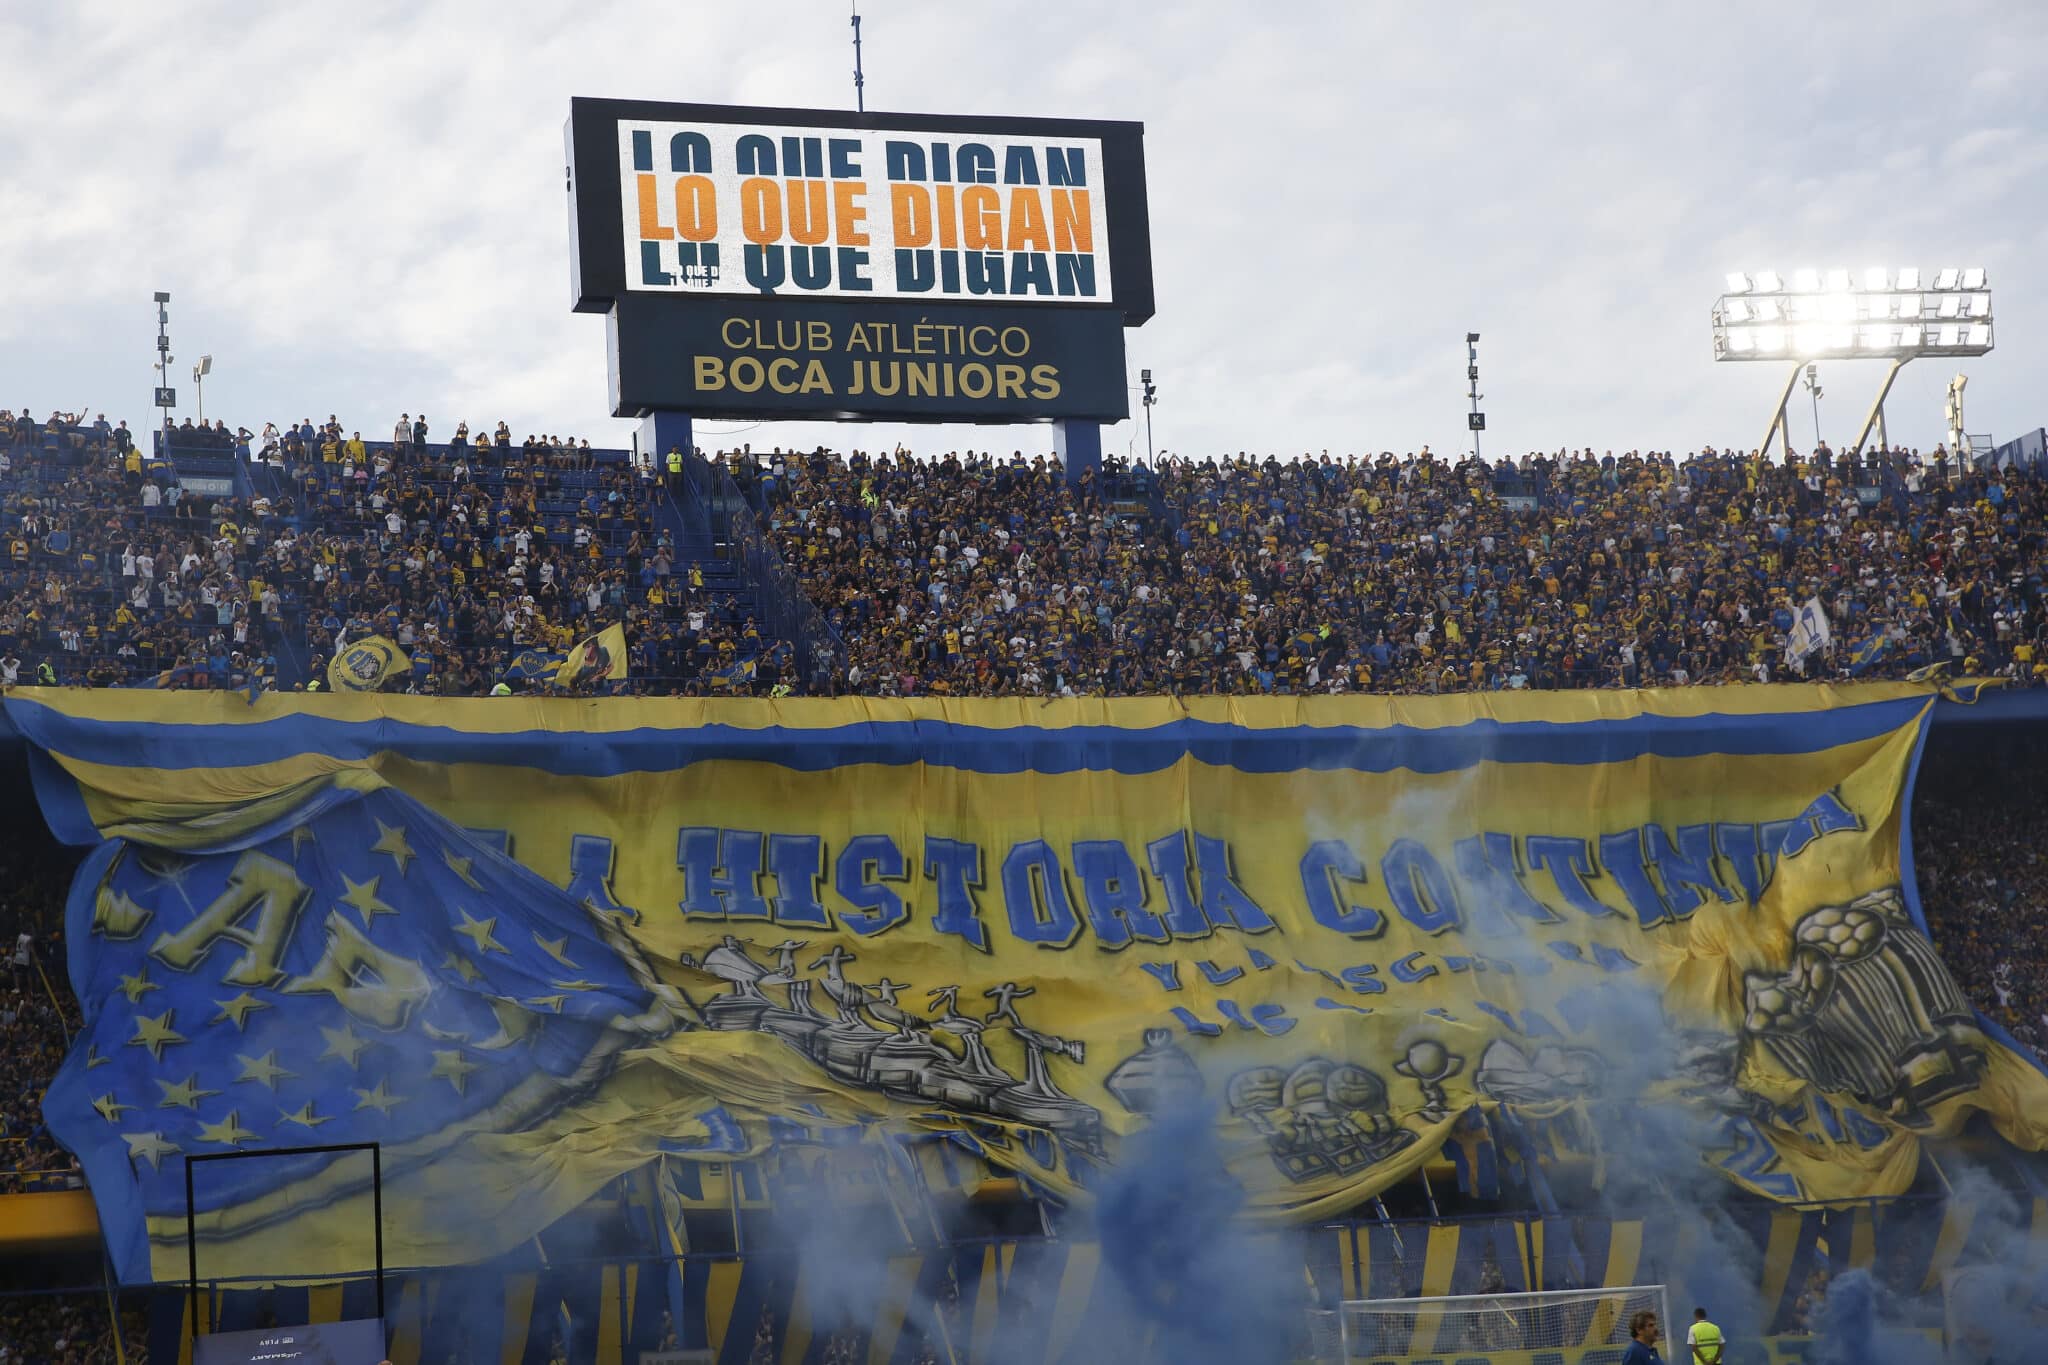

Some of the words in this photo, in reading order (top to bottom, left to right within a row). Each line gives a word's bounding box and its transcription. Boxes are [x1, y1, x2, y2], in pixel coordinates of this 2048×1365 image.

[637, 173, 718, 242] LO
[740, 177, 870, 253] QUE
[890, 183, 1094, 253] DIGAN
[722, 318, 833, 351] CLUB
[847, 316, 1031, 356] ATLÉTICO
[160, 389, 170, 401] K
[694, 355, 834, 393] BOCA
[848, 360, 1060, 400] JUNIORS
[1472, 415, 1480, 424] K
[676, 826, 1284, 954] HISTORIA
